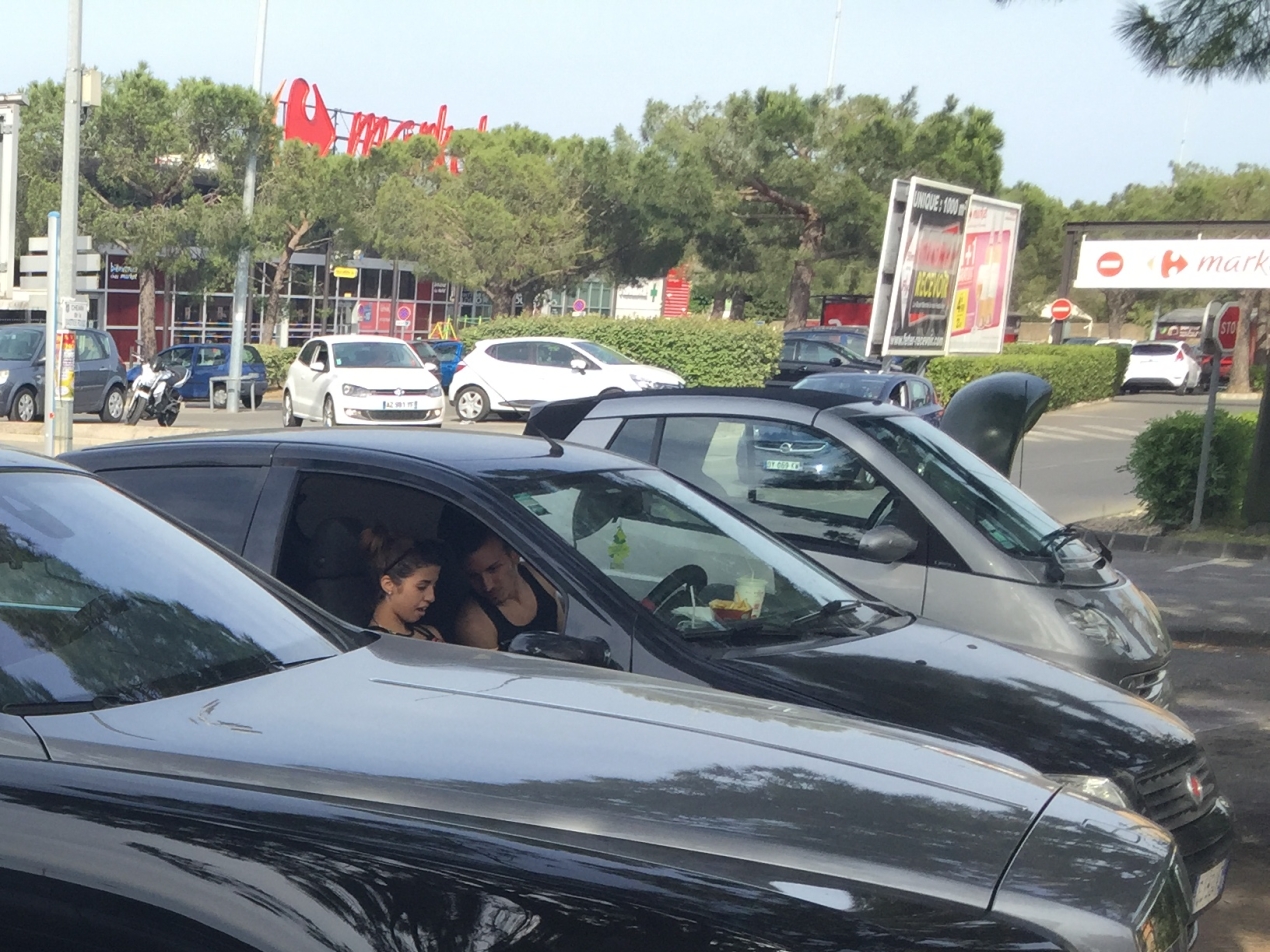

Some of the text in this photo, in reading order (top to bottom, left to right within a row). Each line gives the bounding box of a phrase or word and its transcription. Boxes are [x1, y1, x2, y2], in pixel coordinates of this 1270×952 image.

[912, 190, 940, 212] UNIQUE
[943, 196, 959, 216] 1000
[1220, 321, 1237, 335] STO
